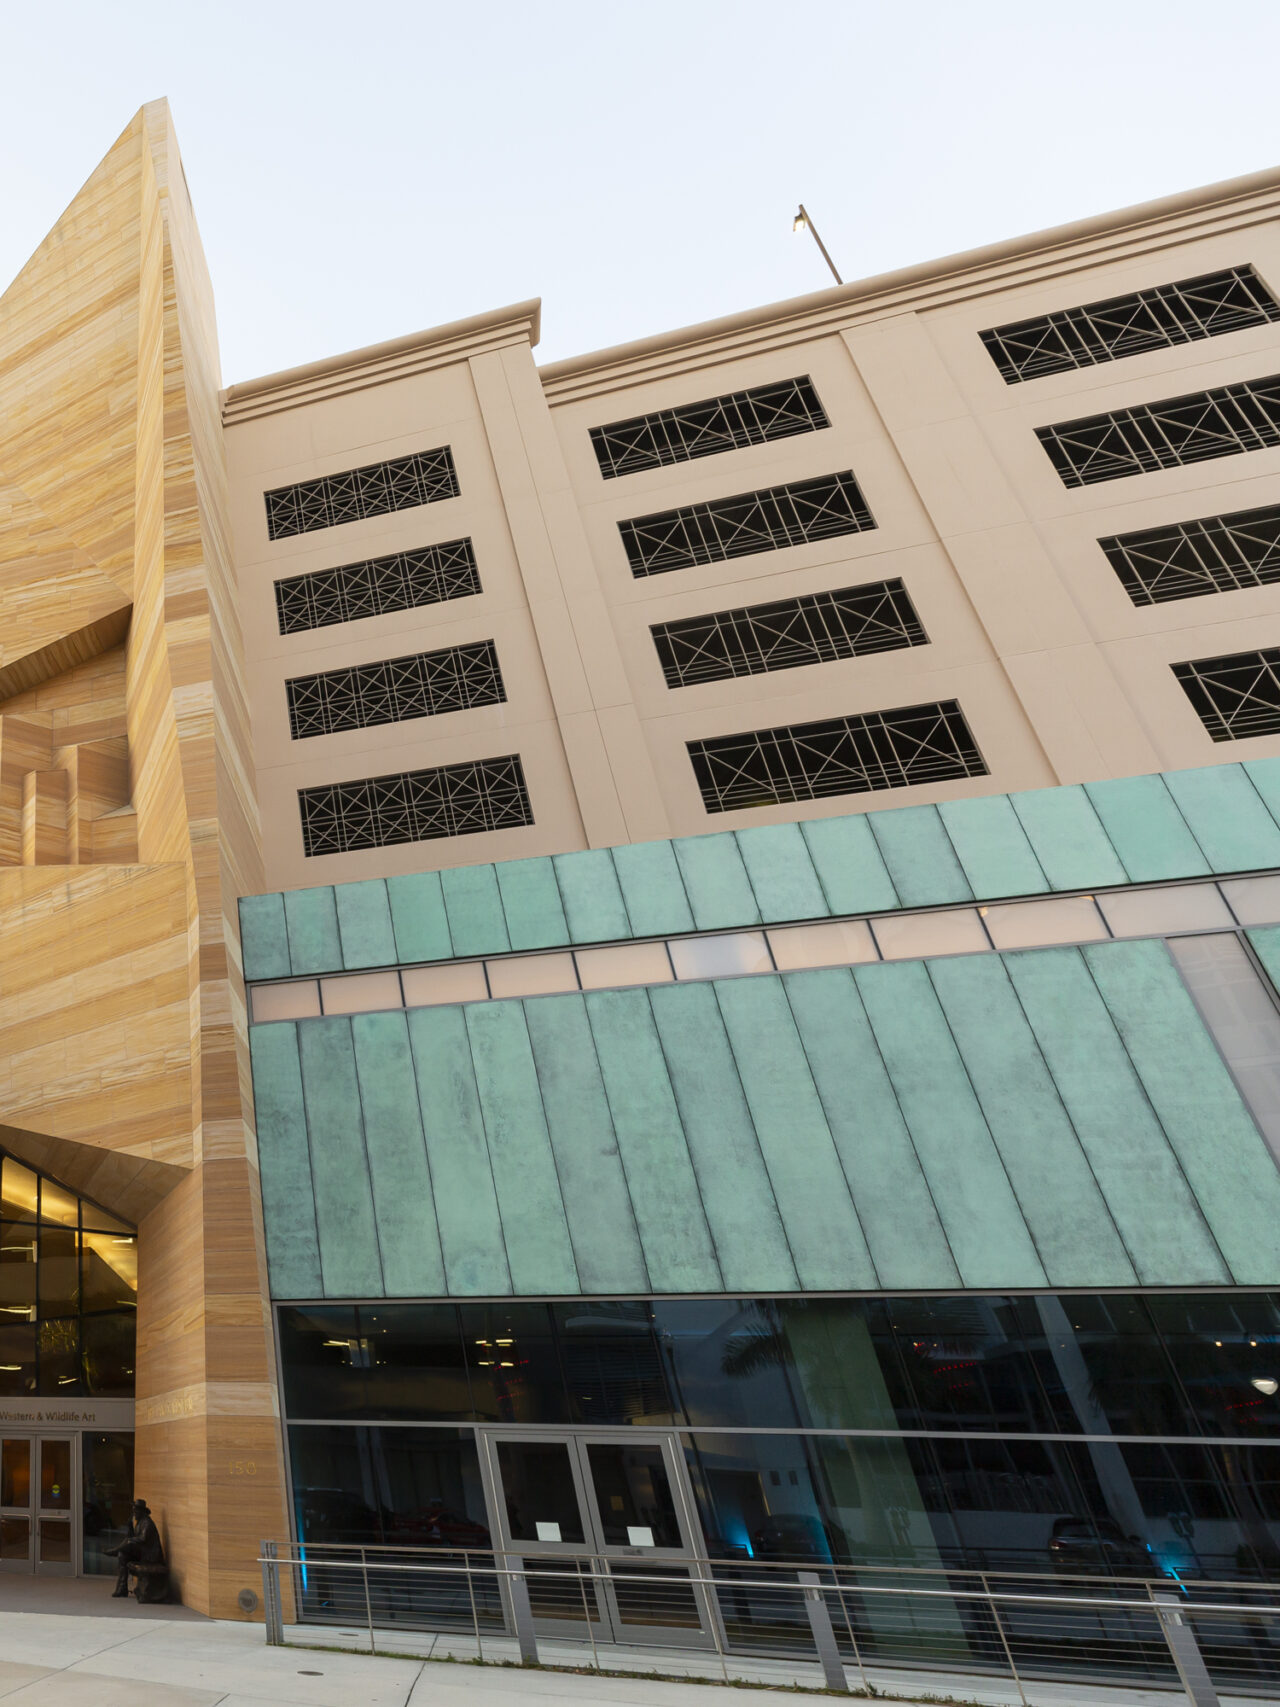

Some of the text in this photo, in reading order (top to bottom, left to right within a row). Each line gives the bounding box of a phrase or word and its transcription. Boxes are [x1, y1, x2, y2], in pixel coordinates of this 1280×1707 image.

[0, 1411, 35, 1421] Western
[36, 1411, 43, 1422] &
[46, 1411, 80, 1422] Wildlife
[82, 1412, 96, 1422] Art
[229, 1461, 257, 1475] 150
